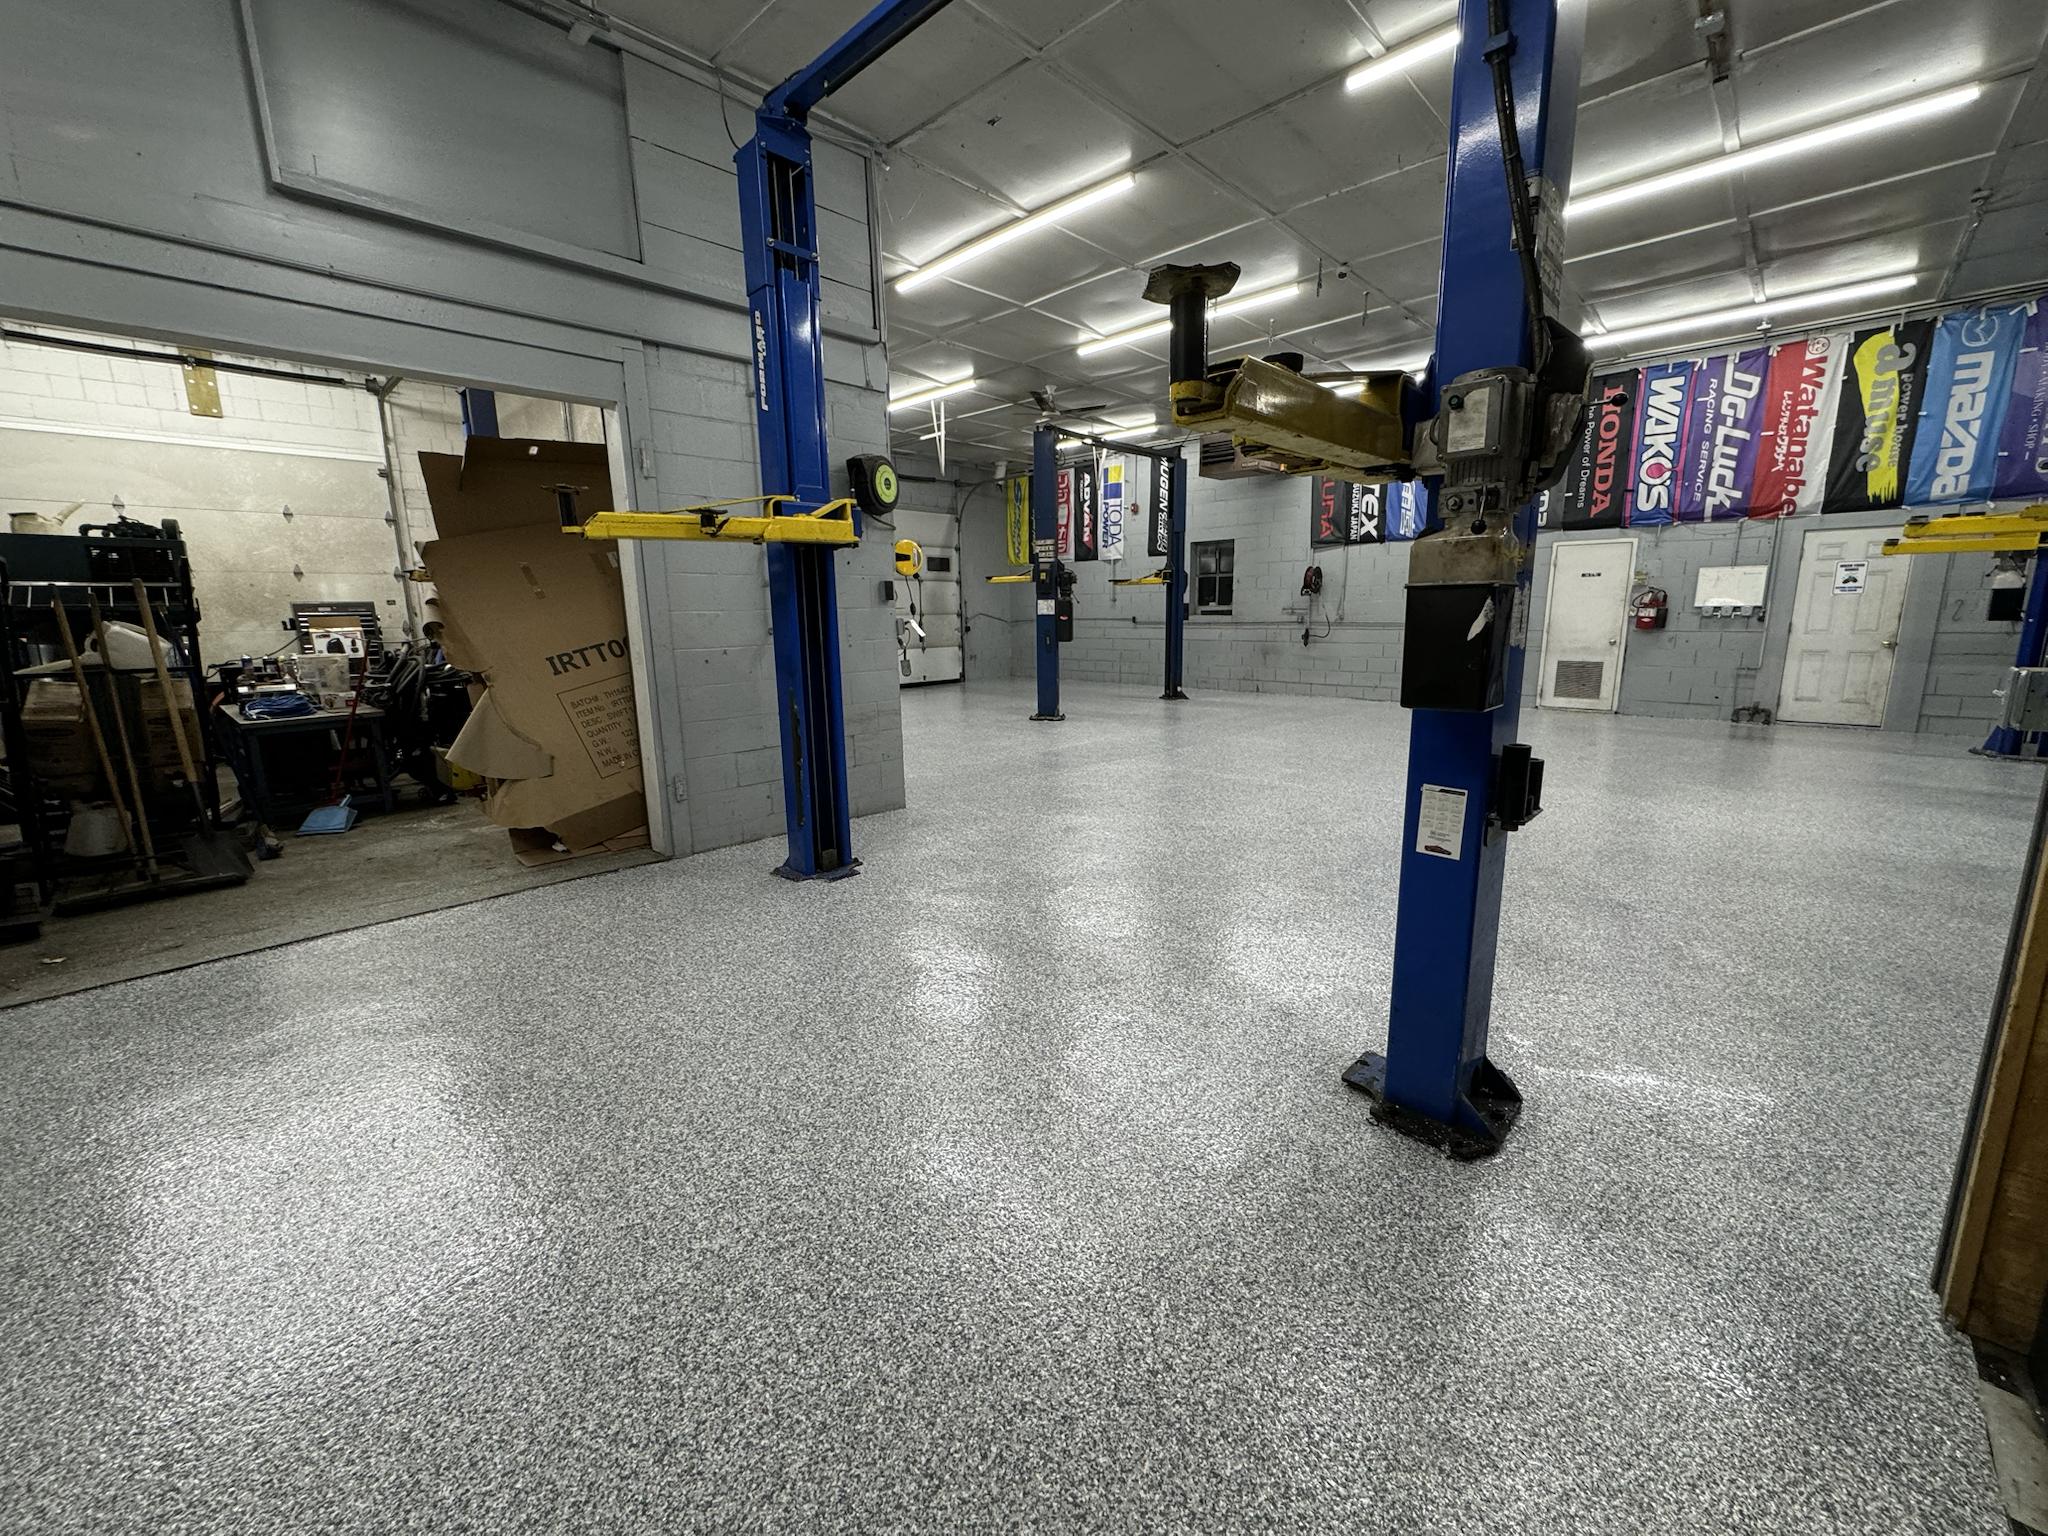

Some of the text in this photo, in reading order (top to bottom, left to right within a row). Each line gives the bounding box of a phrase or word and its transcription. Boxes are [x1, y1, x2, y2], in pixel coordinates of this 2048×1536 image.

[1856, 342, 1916, 472] amuse
[1582, 421, 1596, 455] Power
[1590, 384, 1624, 518] HONDA
[1692, 378, 1718, 502] RACING SERVICE
[1780, 355, 1828, 518] Watanabe
[2025, 424, 2039, 449] SHOP
[1581, 456, 1591, 468] of
[1082, 472, 1091, 542] ADVAN
[1577, 469, 1590, 509] Dreams
[1108, 500, 1122, 548] TODA
[1349, 516, 1358, 540] JAPAN
[586, 721, 622, 738] QUANTITY
